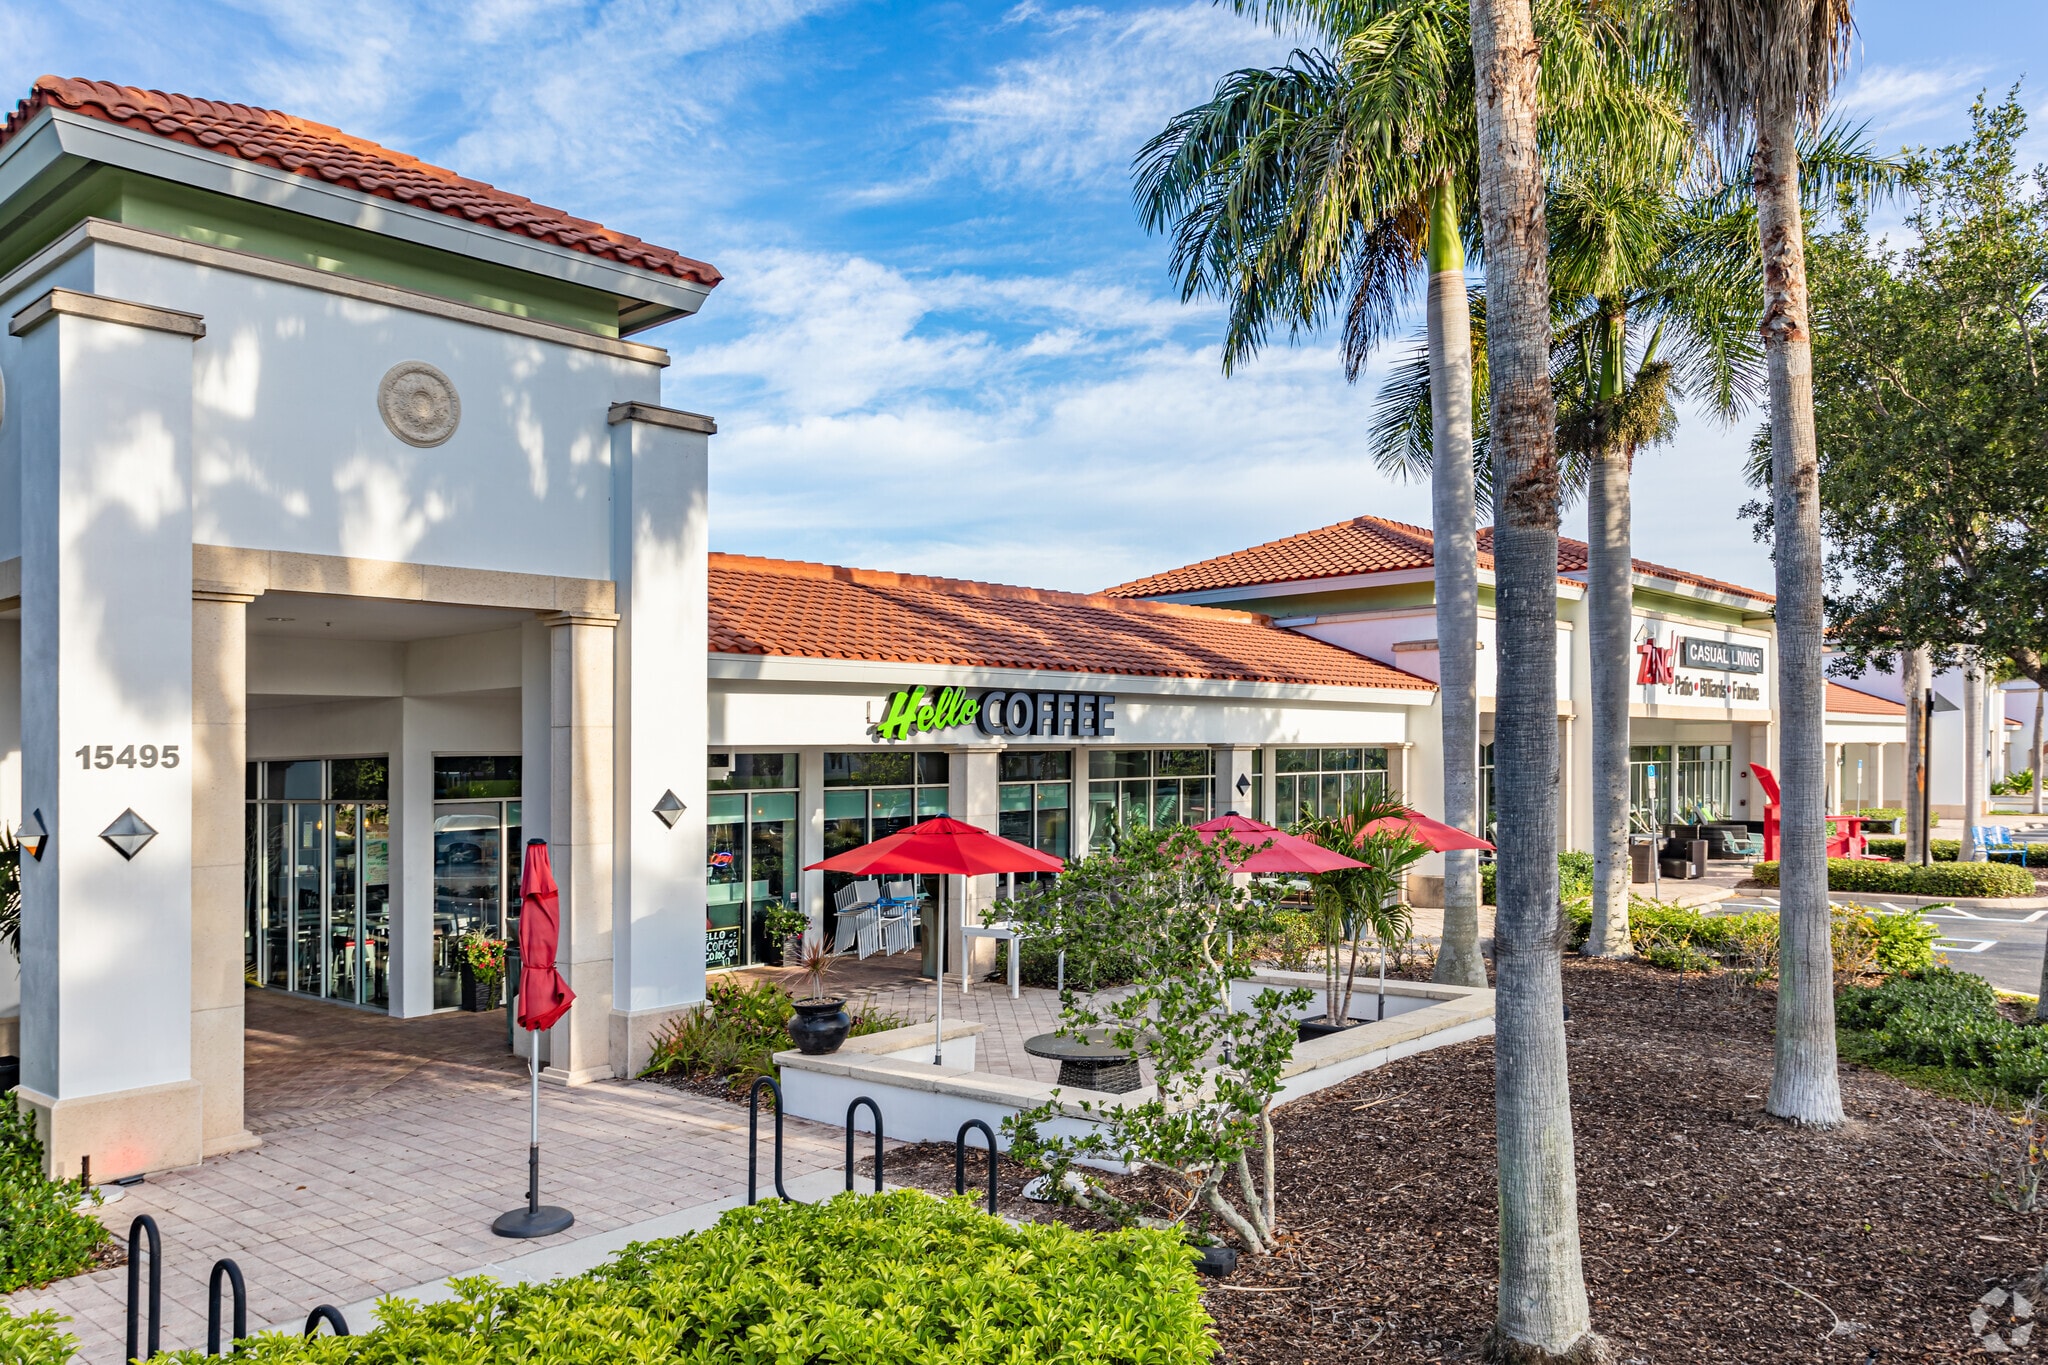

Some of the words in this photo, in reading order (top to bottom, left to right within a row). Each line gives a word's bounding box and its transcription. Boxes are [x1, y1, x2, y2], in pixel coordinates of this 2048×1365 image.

[1690, 643, 1729, 665] CASUAL
[1731, 649, 1760, 668] LIVING
[1674, 675, 1693, 697] Patio
[877, 685, 981, 741] Hello
[979, 691, 1116, 737] COFFEE
[75, 744, 180, 770] 15495
